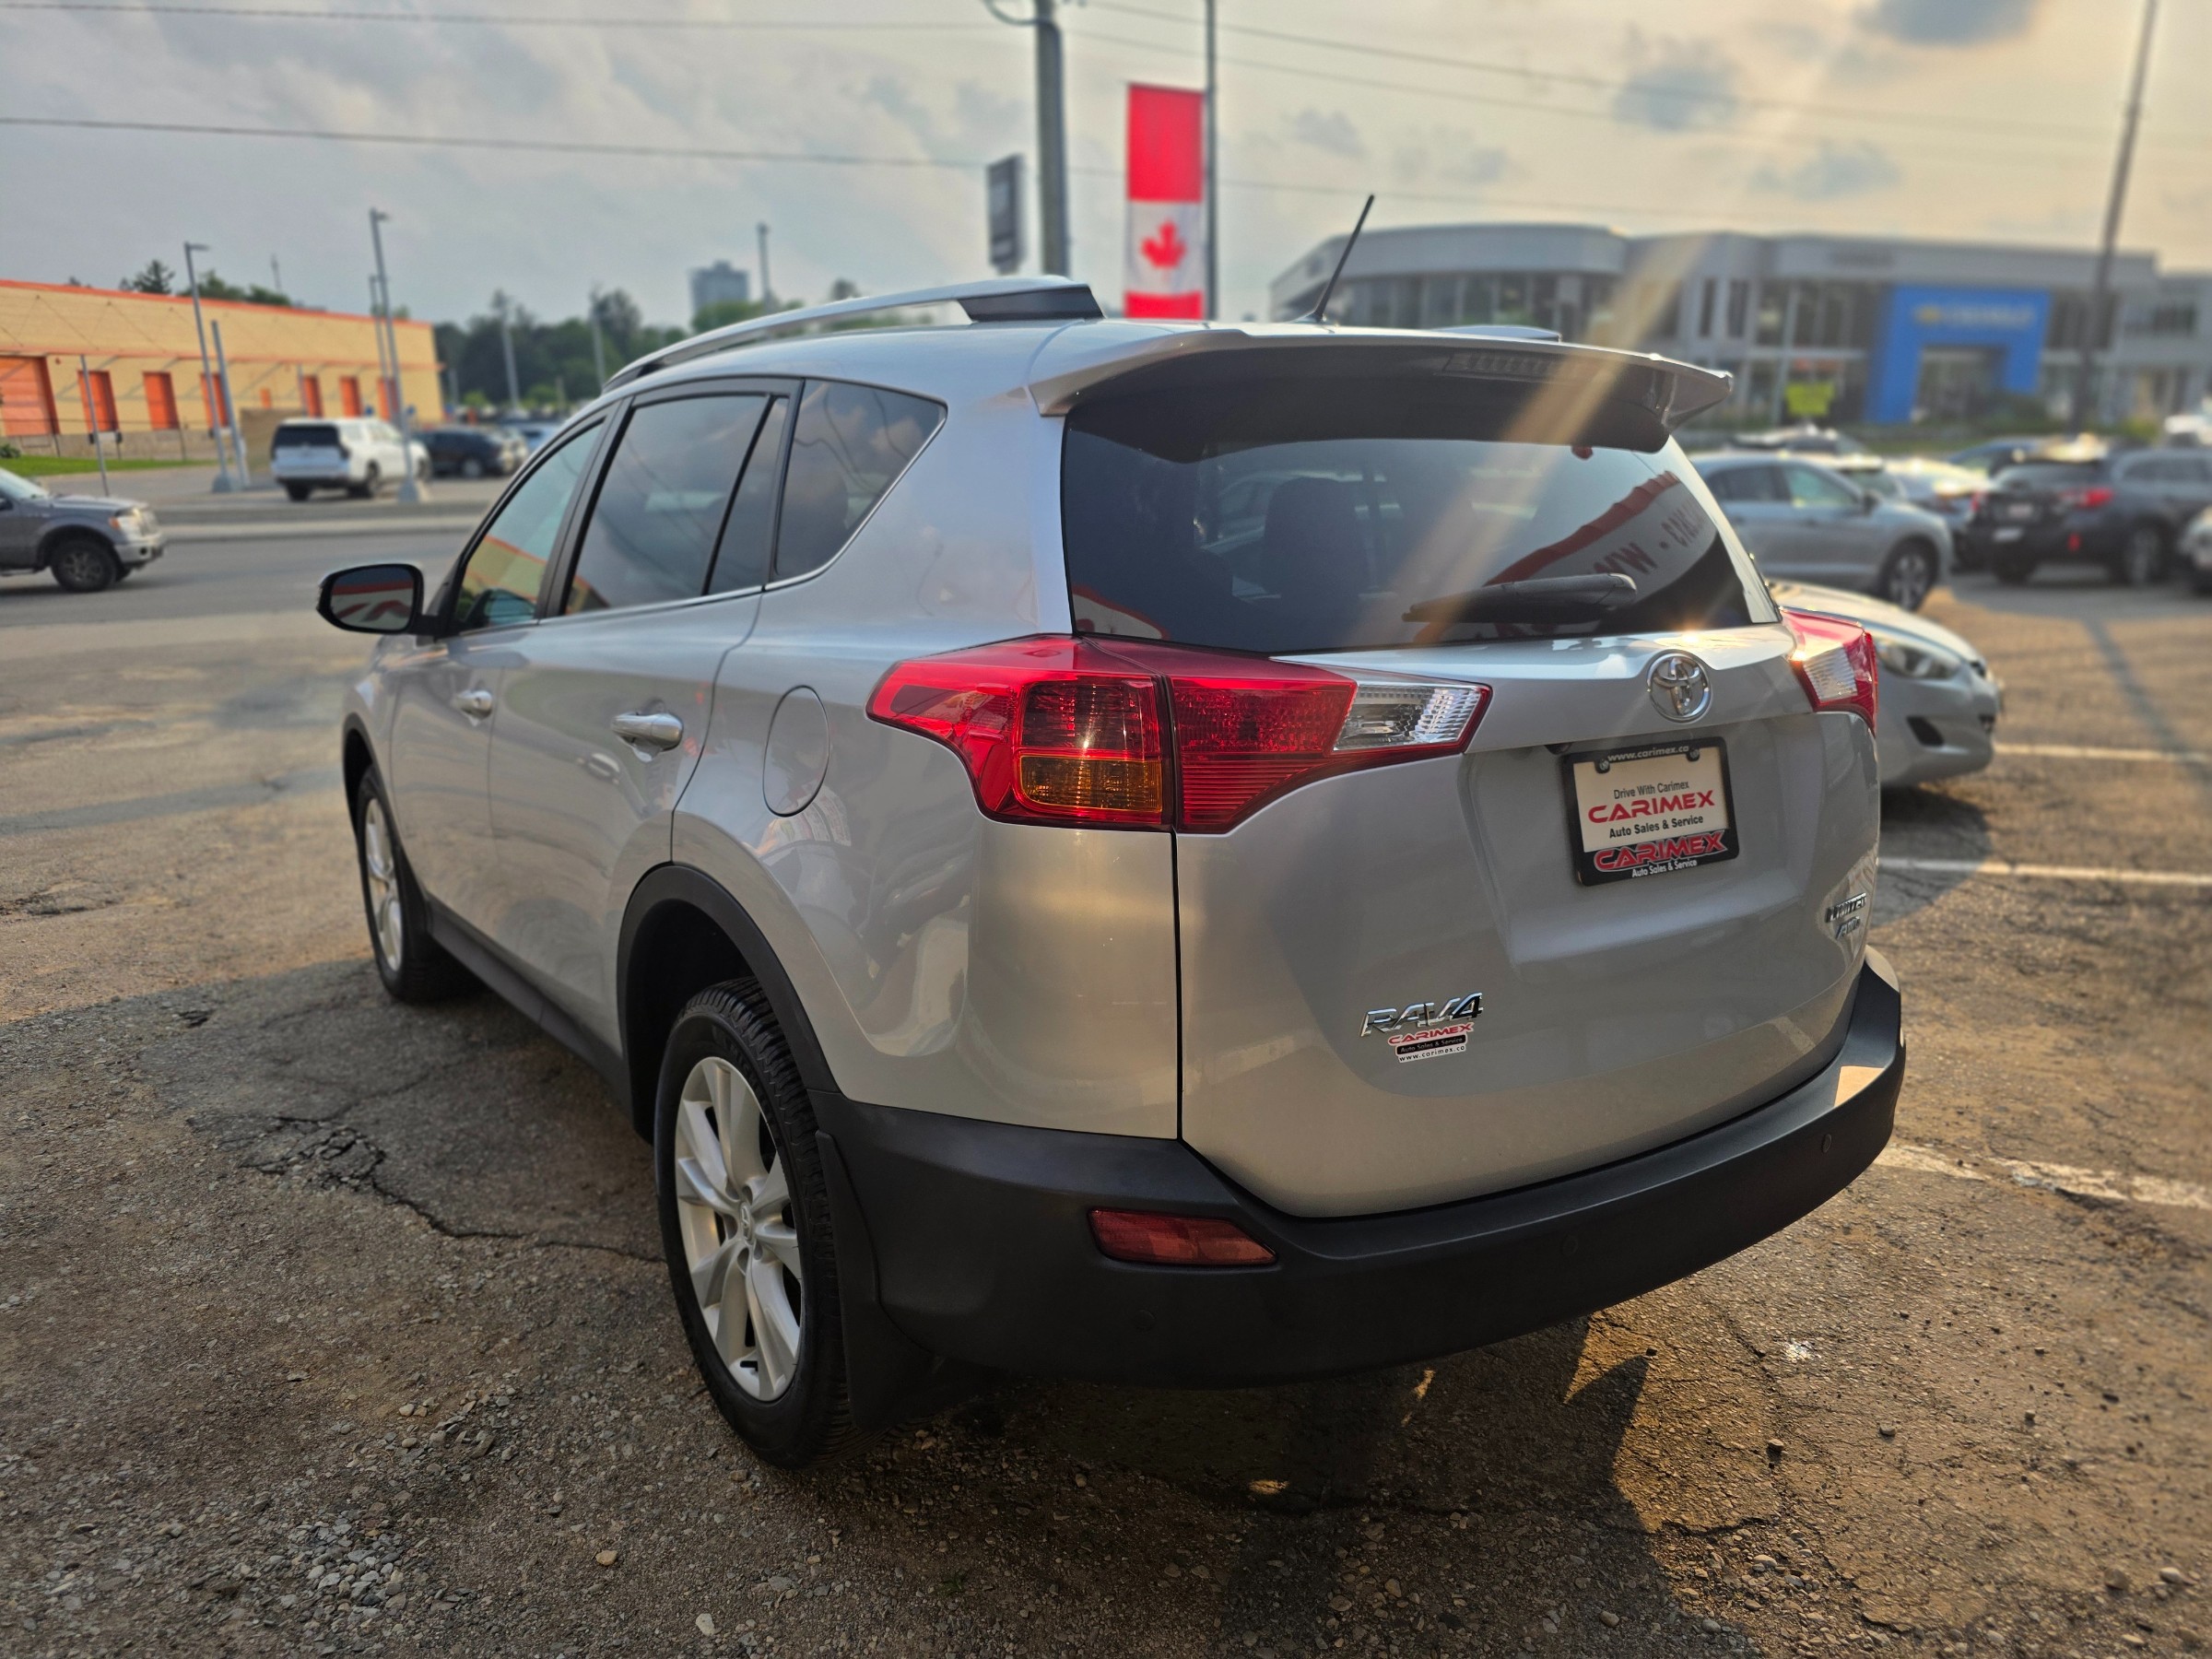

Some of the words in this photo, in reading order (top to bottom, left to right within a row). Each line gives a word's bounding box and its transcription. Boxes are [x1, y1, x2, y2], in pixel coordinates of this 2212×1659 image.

[1607, 745, 1689, 761] www.carimex.ca
[1614, 788, 1636, 799] Drive
[1637, 784, 1656, 795] With
[1658, 781, 1689, 793] Carimex
[1588, 790, 1715, 823] CARIMEX
[1609, 828, 1631, 839] Auto
[1634, 823, 1660, 834] Sales
[1662, 819, 1669, 830] &
[1671, 815, 1703, 829] Service
[1594, 830, 1727, 871] CARIMEX
[1631, 867, 1648, 877] Auto
[1649, 864, 1667, 875] Sales
[1667, 862, 1674, 871] &
[1674, 858, 1698, 870] Service
[1360, 992, 1484, 1037] RAV4
[1388, 1023, 1472, 1044] CARIMEX
[1441, 1037, 1463, 1046] Service
[1399, 1045, 1465, 1062] www.carimex.ca
